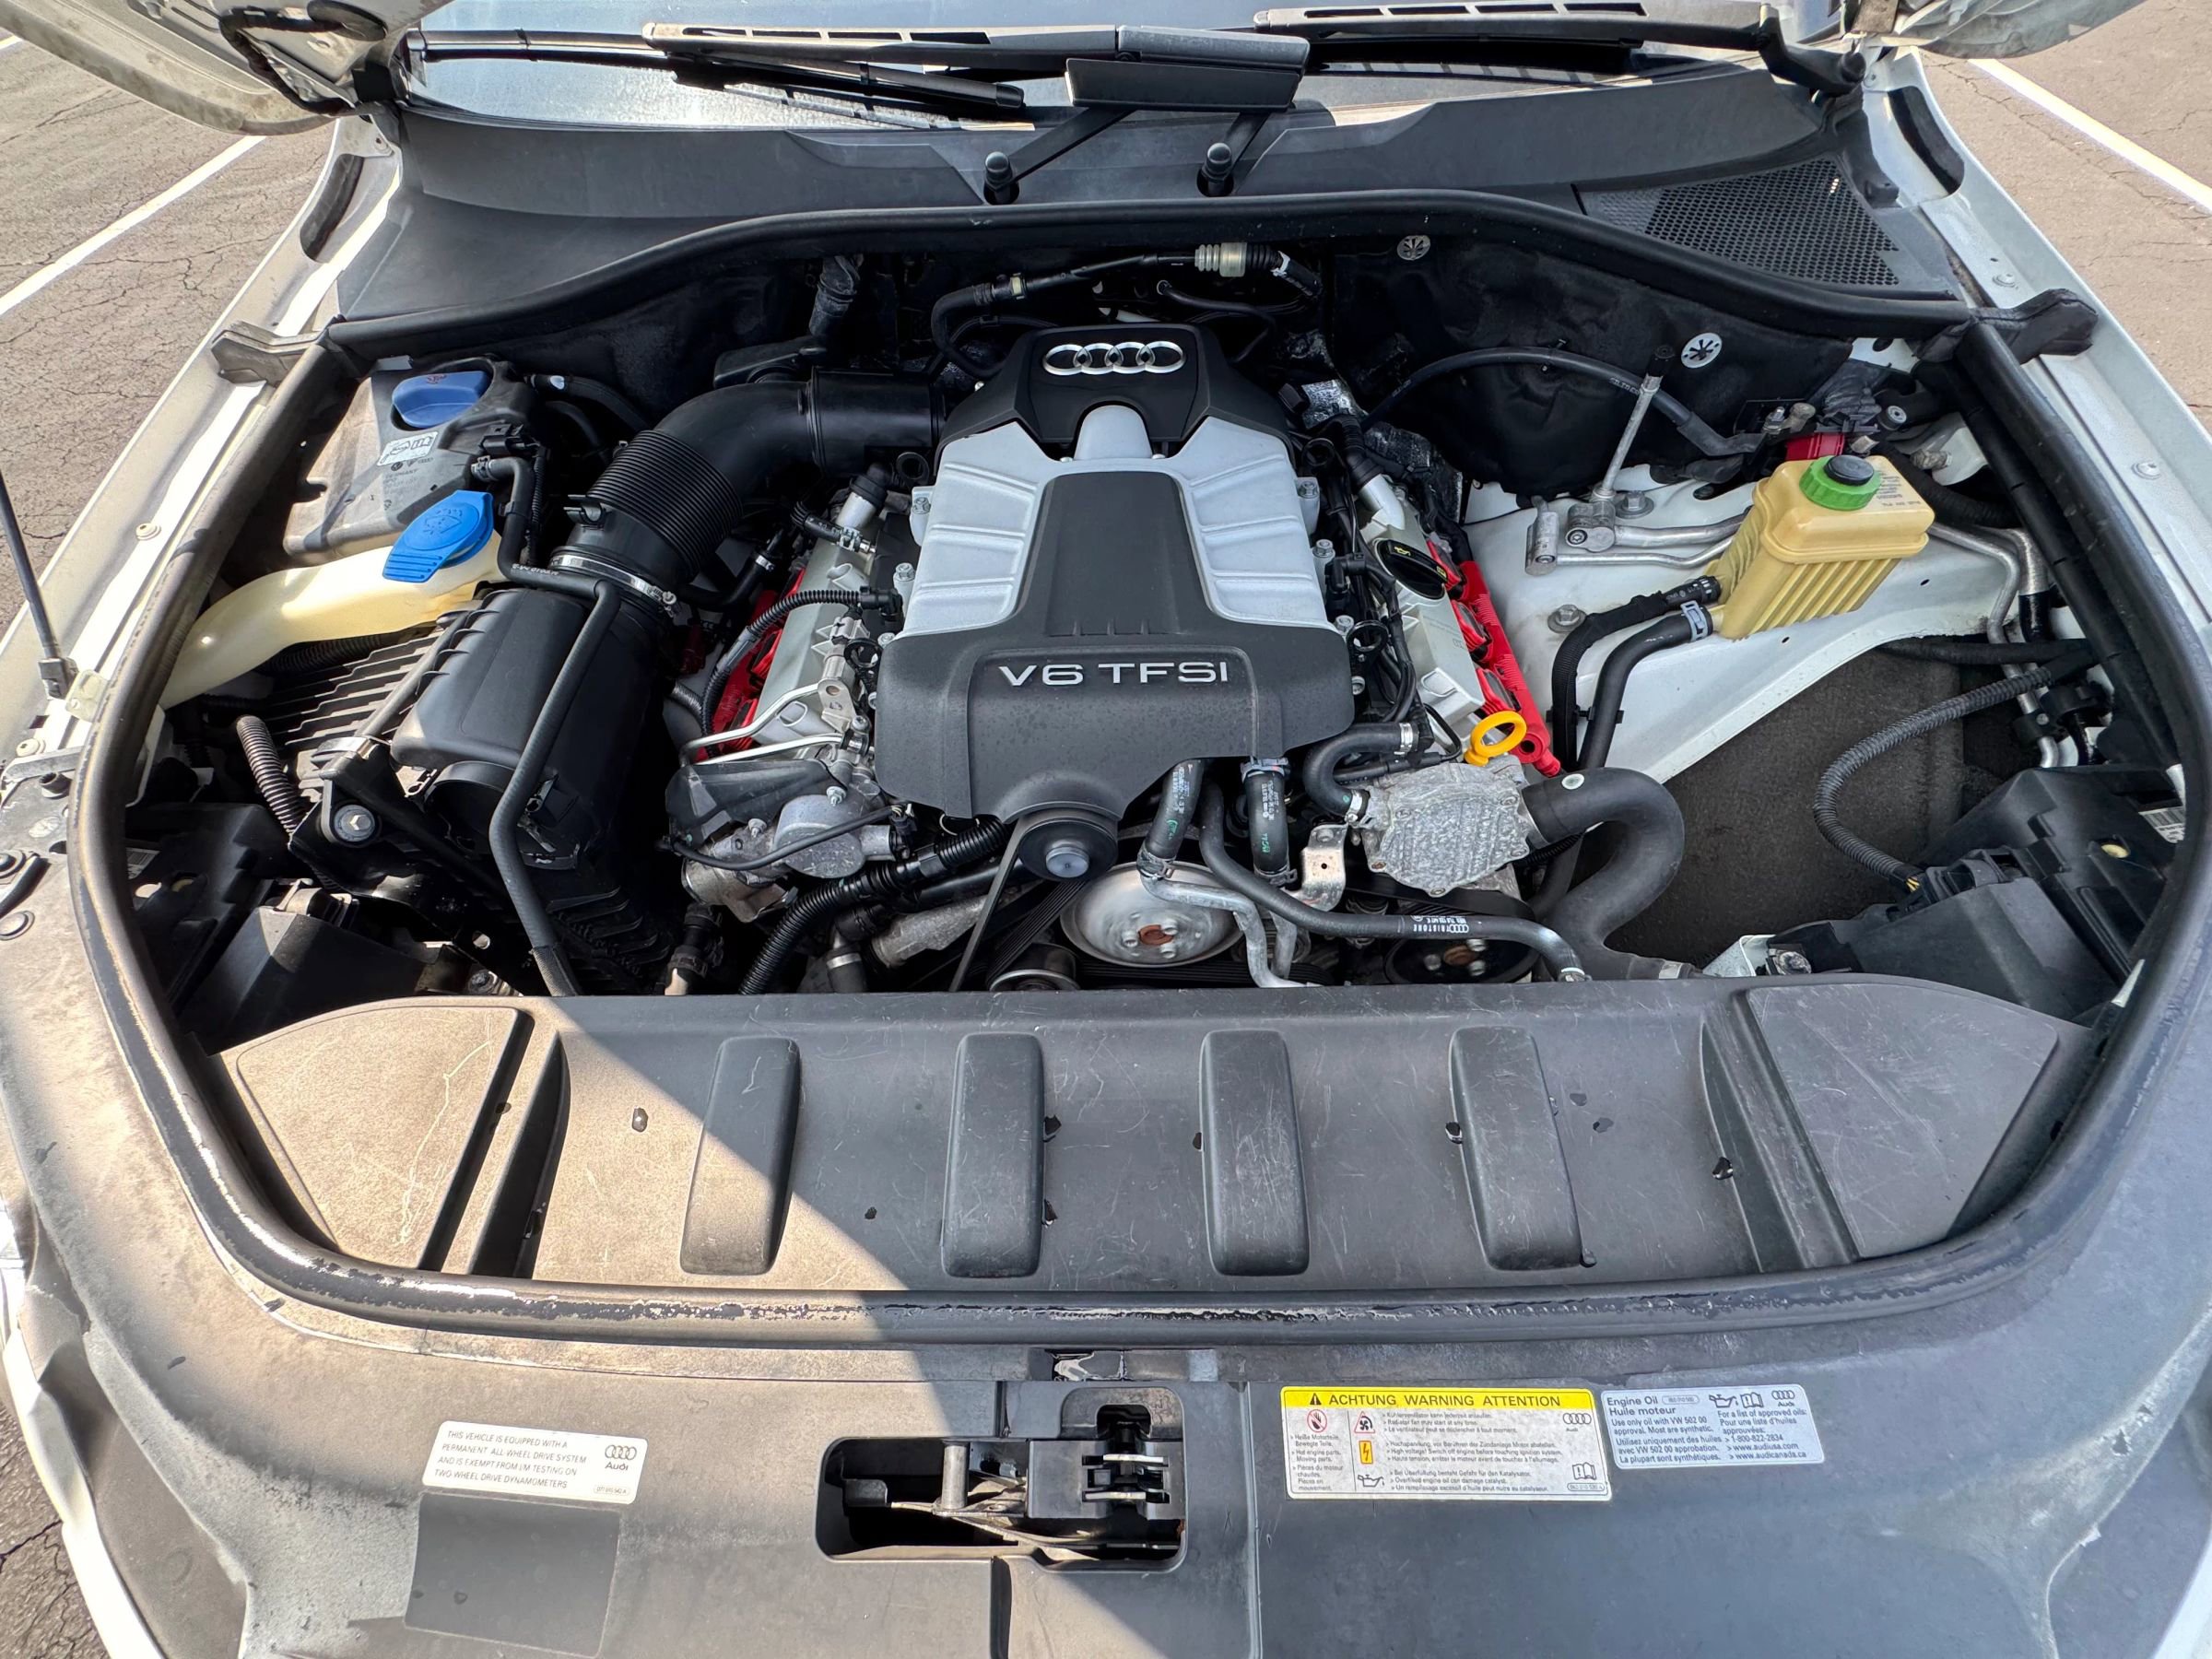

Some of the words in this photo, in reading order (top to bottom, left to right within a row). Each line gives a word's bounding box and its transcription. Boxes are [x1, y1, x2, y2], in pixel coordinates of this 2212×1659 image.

[998, 664, 1084, 687] V6
[1098, 661, 1228, 684] TFSI
[1328, 1394, 1396, 1406] ACHTUNG
[1404, 1394, 1475, 1407] WARNING
[1482, 1394, 1561, 1407] ATTENTION
[1606, 1396, 1641, 1406] Engine
[1644, 1395, 1659, 1405] Oil
[1609, 1407, 1635, 1417] Huile
[1638, 1407, 1676, 1416] moteur
[1758, 1409, 1792, 1418] approved
[1611, 1418, 1626, 1427] Use
[1627, 1418, 1642, 1427] only
[1614, 1427, 1646, 1436] approval.
[1679, 1425, 1714, 1434] synthetic.
[447, 1430, 464, 1439] THIS
[465, 1431, 494, 1441] VEHICLE
[504, 1436, 541, 1446] EQUIPPED
[542, 1439, 560, 1448] WITH
[1642, 1437, 1686, 1447] uniquement
[1700, 1435, 1723, 1443] huiles
[1650, 1445, 1663, 1453] 502
[1675, 1444, 1720, 1453] approbation.
[1733, 1443, 1799, 1452] www.audiusa.com
[442, 1443, 488, 1453] PERMANENT
[533, 1452, 554, 1461] DRIVE
[556, 1453, 587, 1464] SYSTEM
[1735, 1451, 1806, 1460] www.audicanada.ca
[605, 1461, 629, 1471] Audi
[1630, 1456, 1656, 1465] plupart
[438, 1456, 454, 1465] AND
[455, 1457, 463, 1465] IS
[465, 1458, 495, 1468] EXEMPT
[496, 1461, 518, 1470] FROM
[533, 1465, 564, 1475] TESTING
[565, 1467, 577, 1477] ON
[435, 1468, 452, 1478] TWO
[453, 1470, 478, 1480] WHEEL
[480, 1473, 502, 1483] DRIVE
[503, 1475, 568, 1488] DYNAMOMETERS
